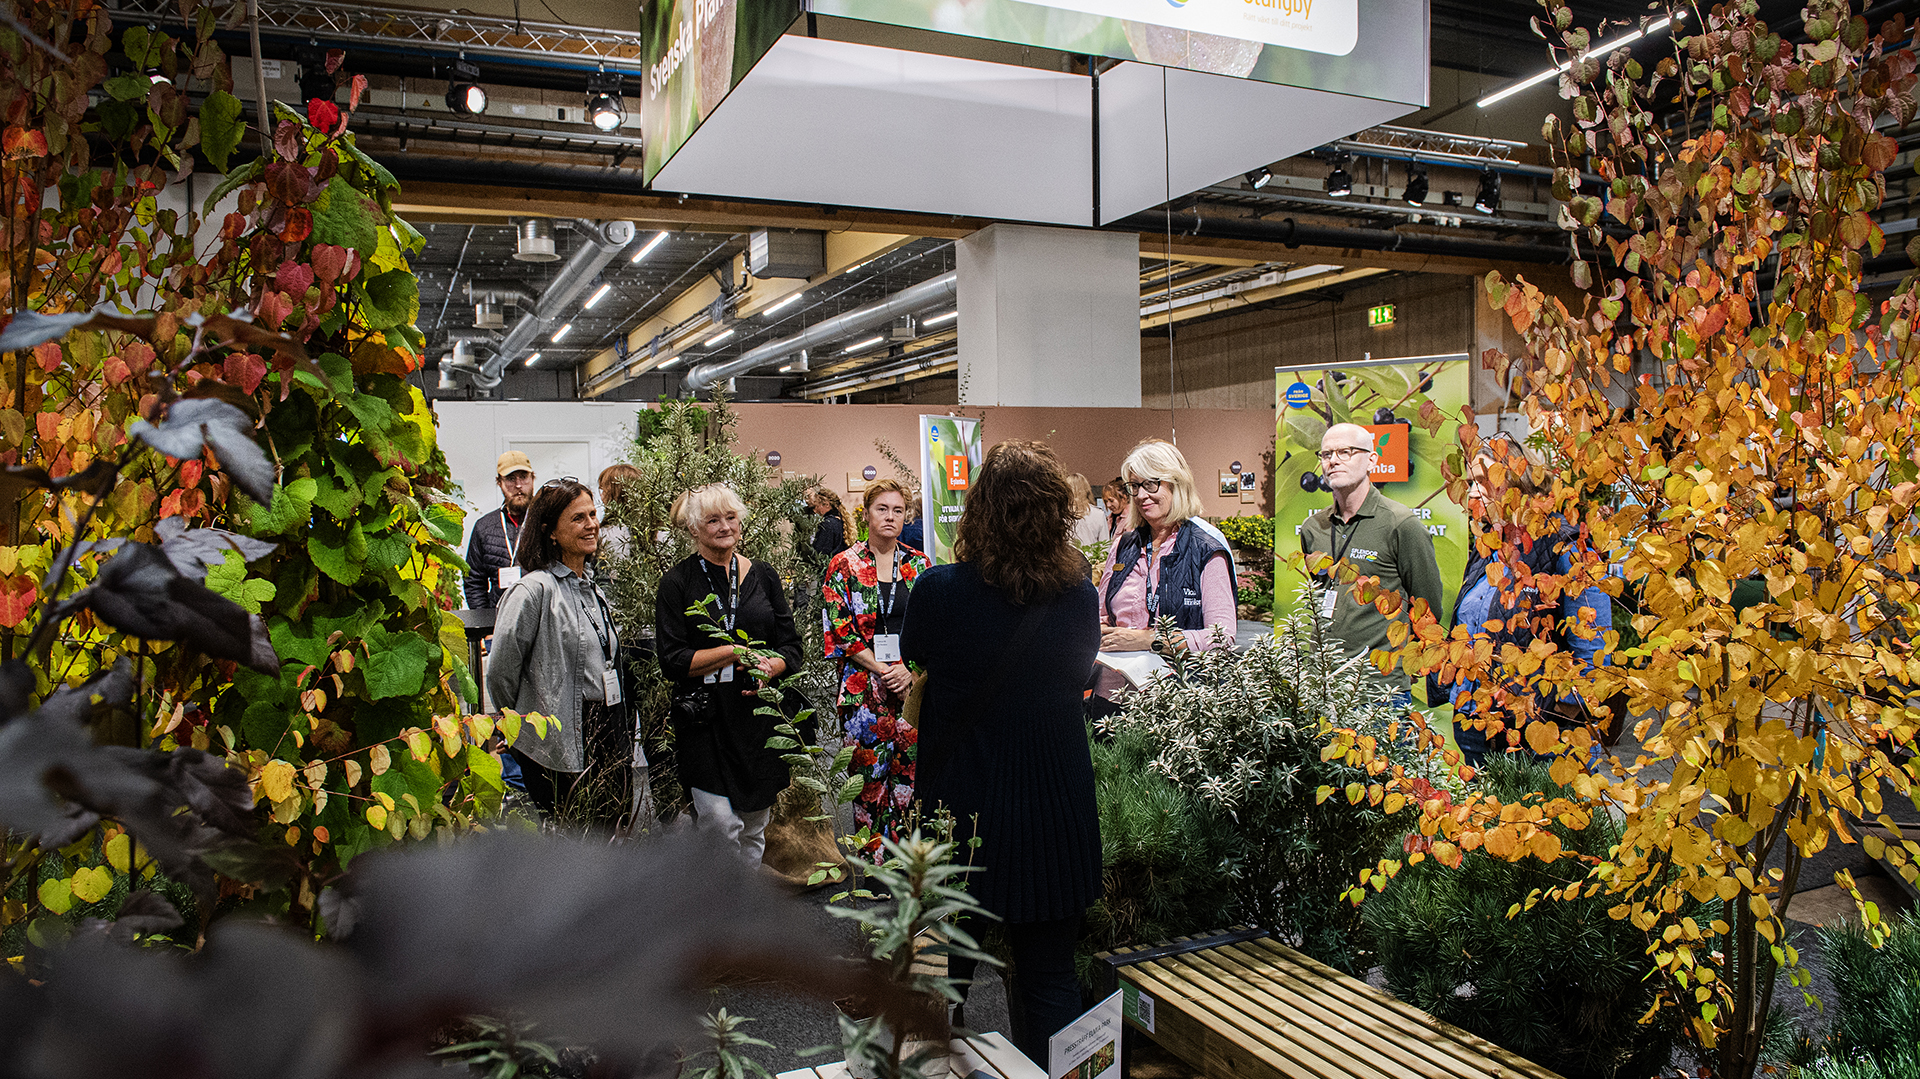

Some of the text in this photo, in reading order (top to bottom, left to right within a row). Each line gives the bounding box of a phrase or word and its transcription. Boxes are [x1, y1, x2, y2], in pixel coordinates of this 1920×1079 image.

[1271, 17, 1279, 26] till
[1280, 19, 1291, 28] ditt
[1291, 22, 1313, 32] projekt
[650, 20, 693, 101] Svenska
